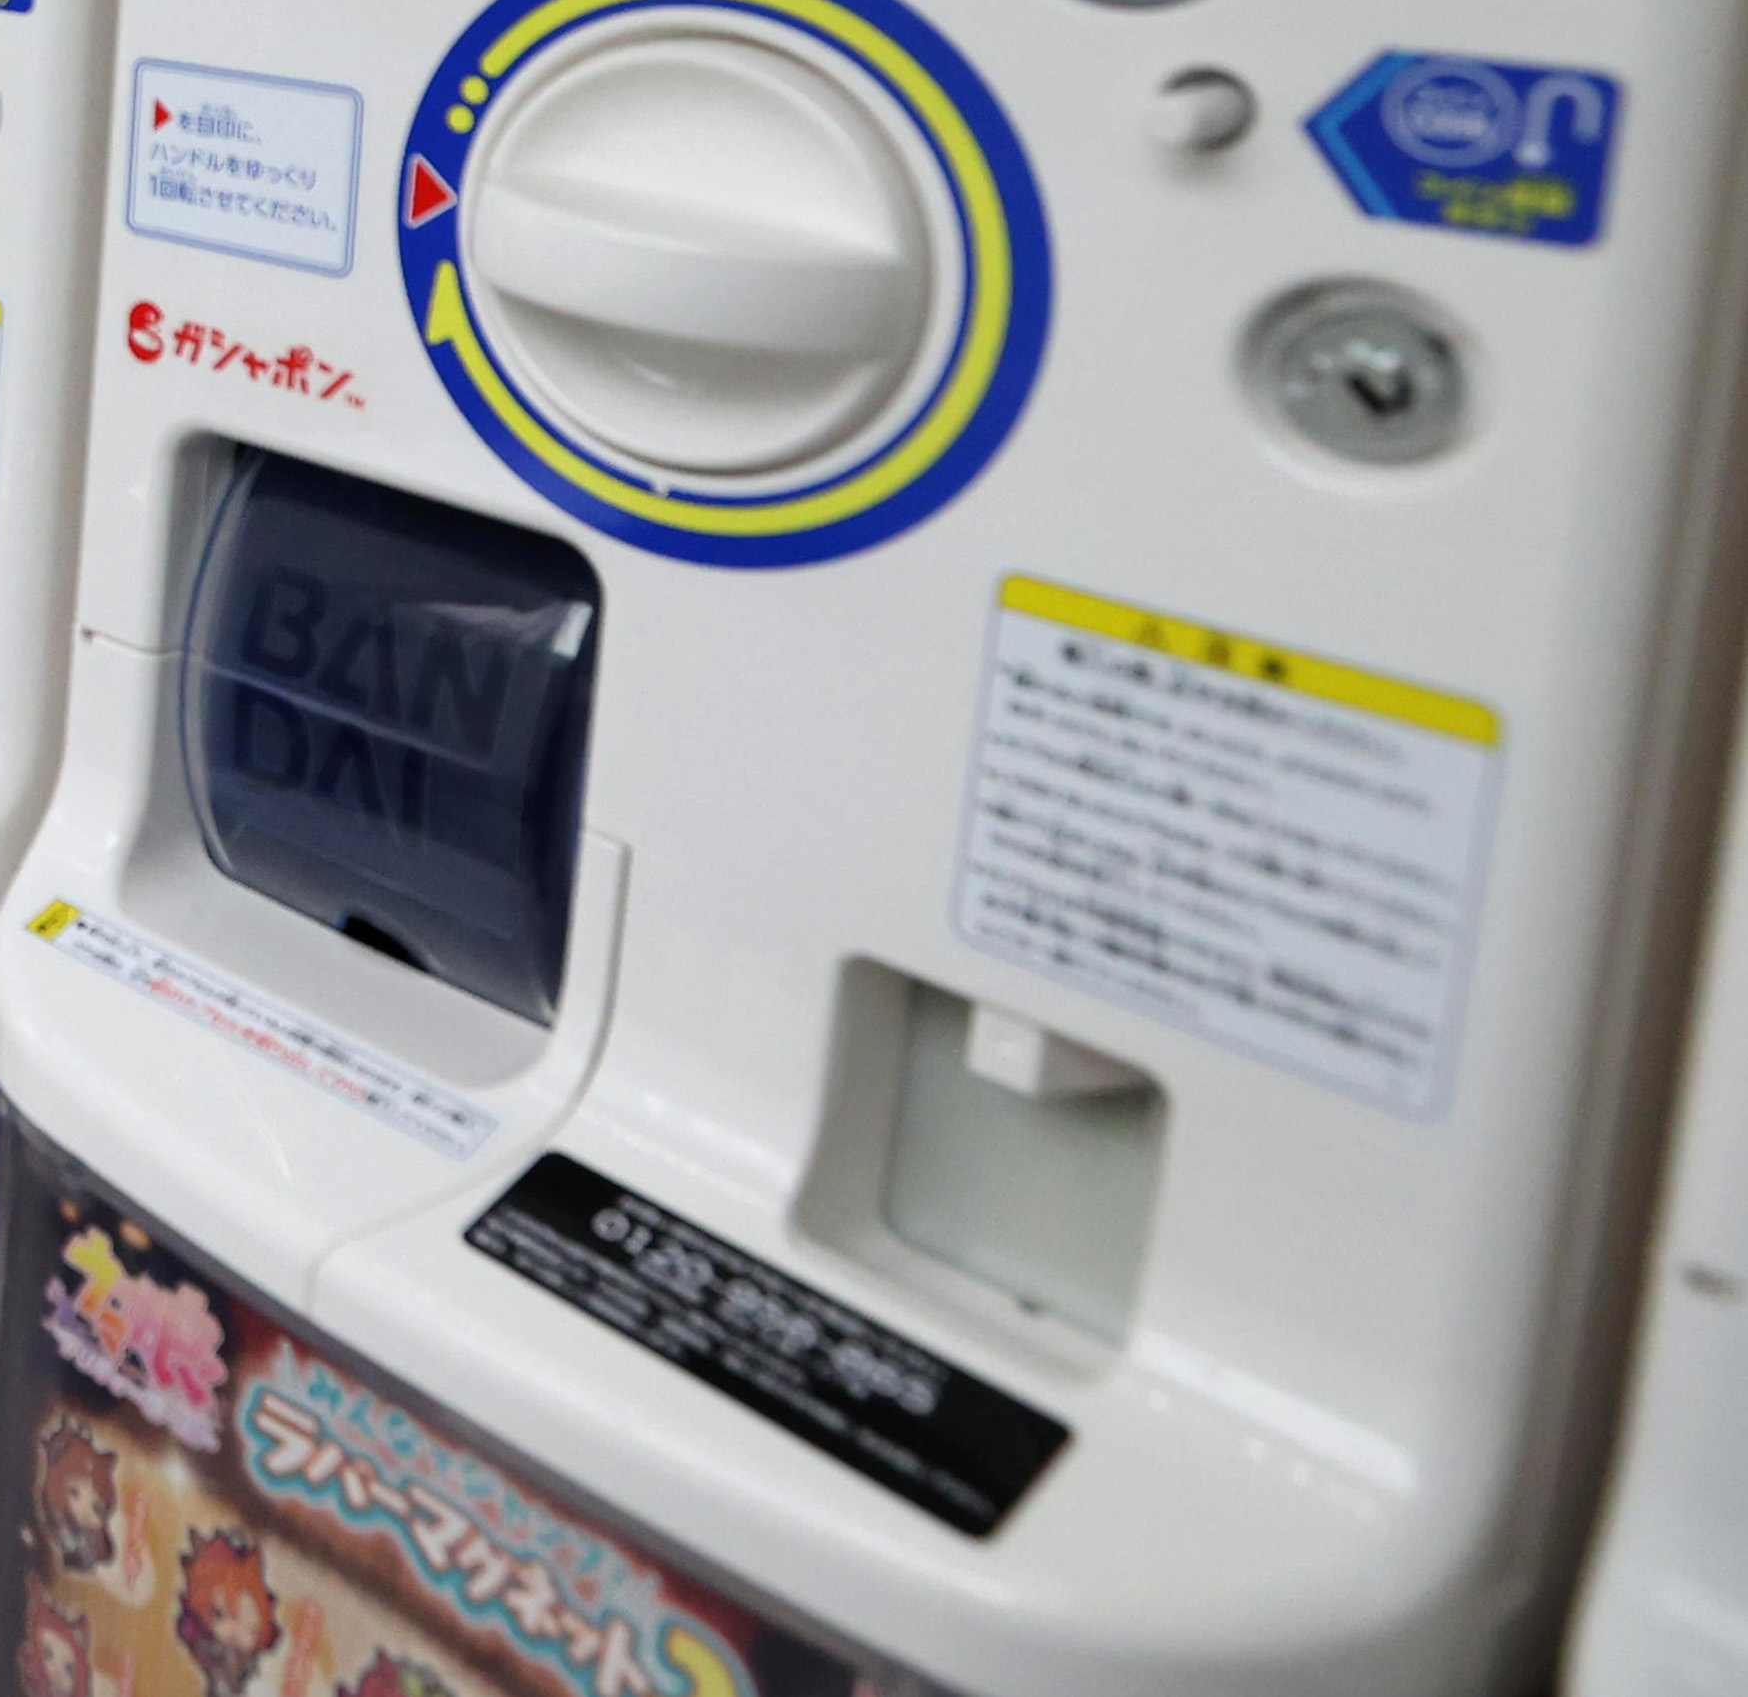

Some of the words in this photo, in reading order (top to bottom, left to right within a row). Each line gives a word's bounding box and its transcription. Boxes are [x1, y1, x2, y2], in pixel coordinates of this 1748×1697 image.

[150, 143, 317, 191] ハンドルをゆっくり
[173, 320, 353, 401] ガシャポン
[241, 565, 516, 763] BAN
